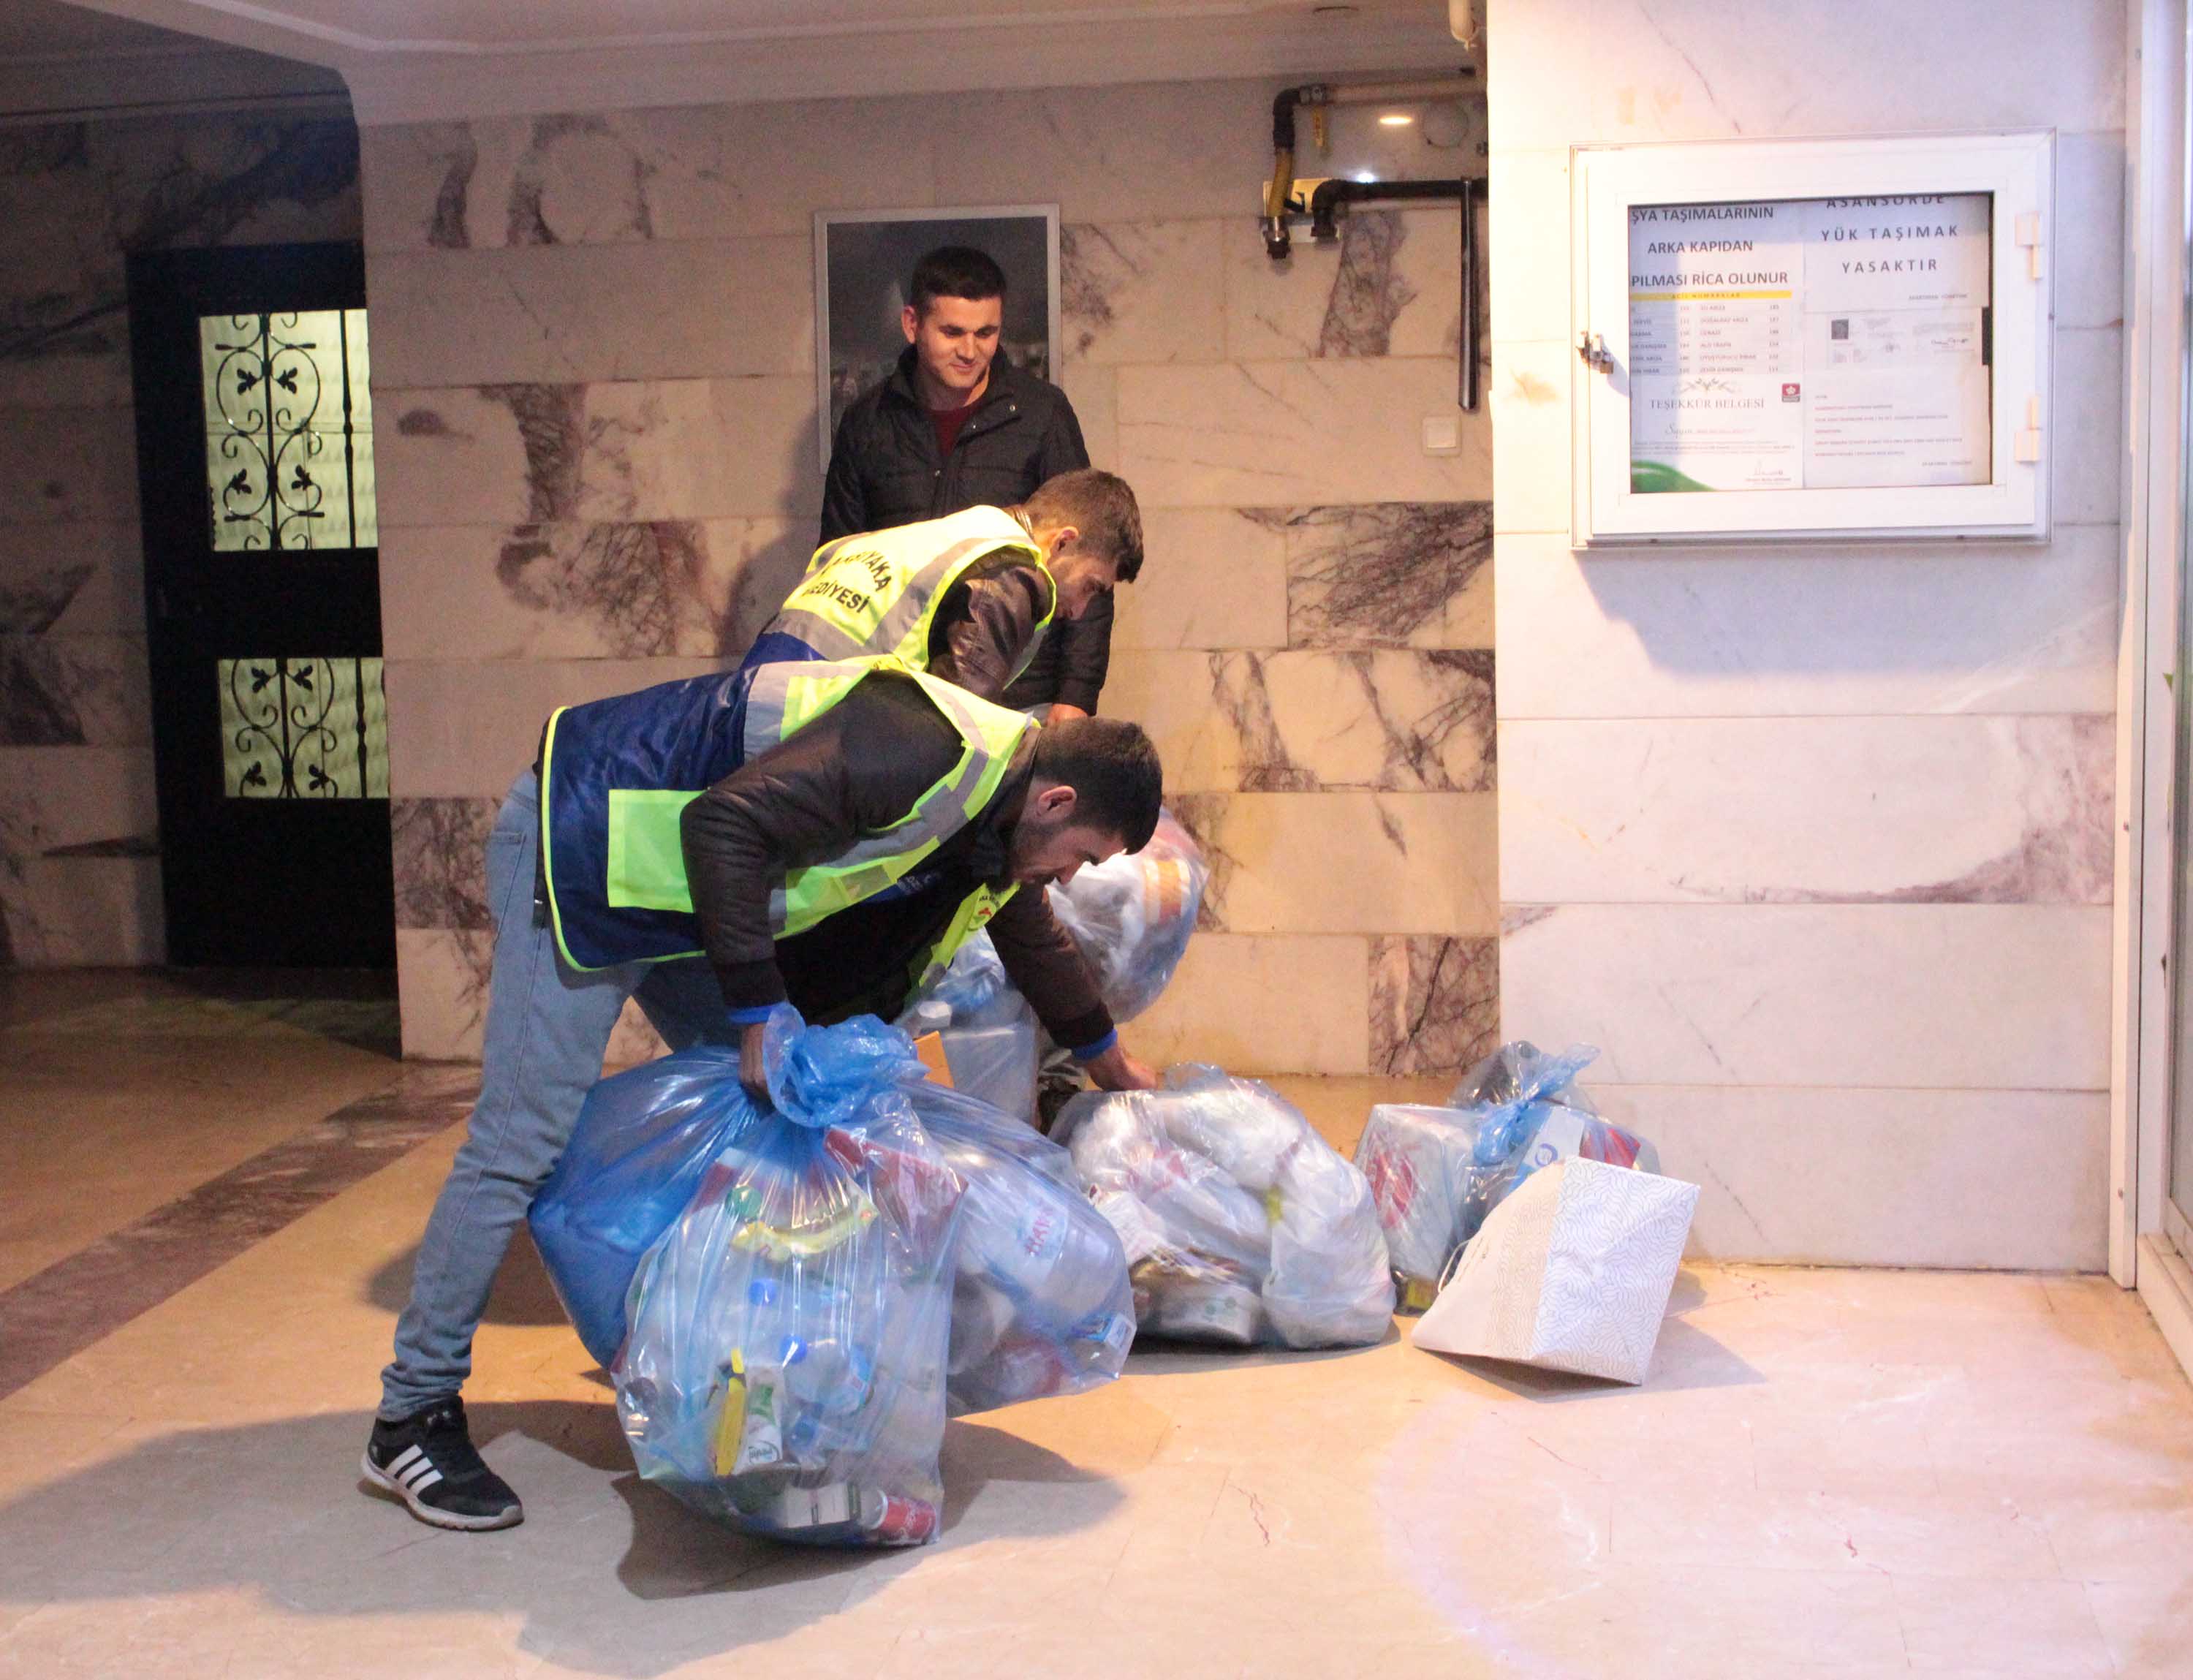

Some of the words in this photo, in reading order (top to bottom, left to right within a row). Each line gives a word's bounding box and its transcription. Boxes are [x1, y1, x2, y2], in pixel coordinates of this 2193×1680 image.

[1662, 206, 1774, 223] TAŞIMALARININ
[1821, 226, 1858, 242] YÜK
[1868, 224, 1958, 242] TAŞIMAK
[1647, 241, 1685, 254] ARKA
[1689, 239, 1754, 253] KAPIDAN
[1841, 258, 1938, 273] YASAKTIR
[1692, 270, 1724, 285] RİCA
[1728, 271, 1789, 284] OLUNUR
[1650, 398, 1711, 410] TEŞEKKÜR
[1715, 397, 1765, 409] BELGESİ
